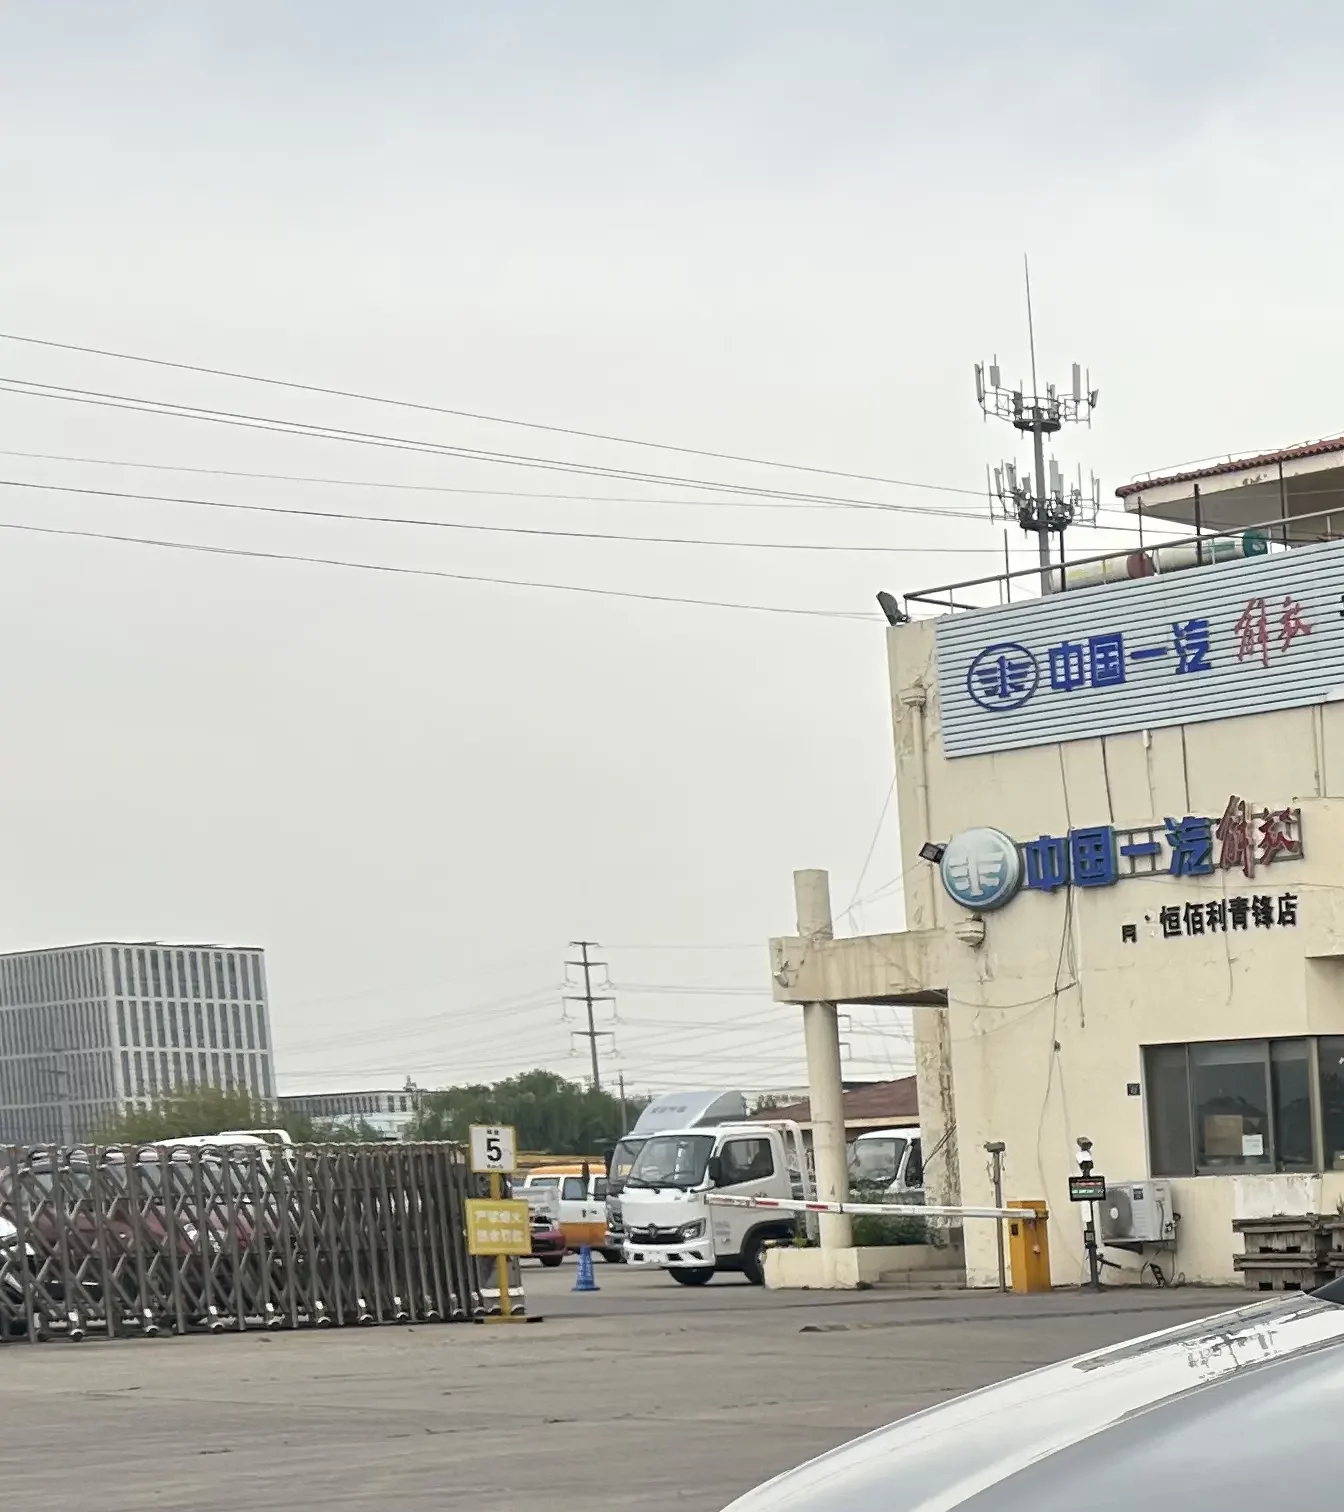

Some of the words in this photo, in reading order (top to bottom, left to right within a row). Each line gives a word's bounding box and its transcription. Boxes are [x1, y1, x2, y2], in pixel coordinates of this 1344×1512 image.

[1048, 617, 1212, 692] 中国一汽
[1025, 815, 1215, 893] 中国一汽
[487, 1138, 502, 1162] 5
